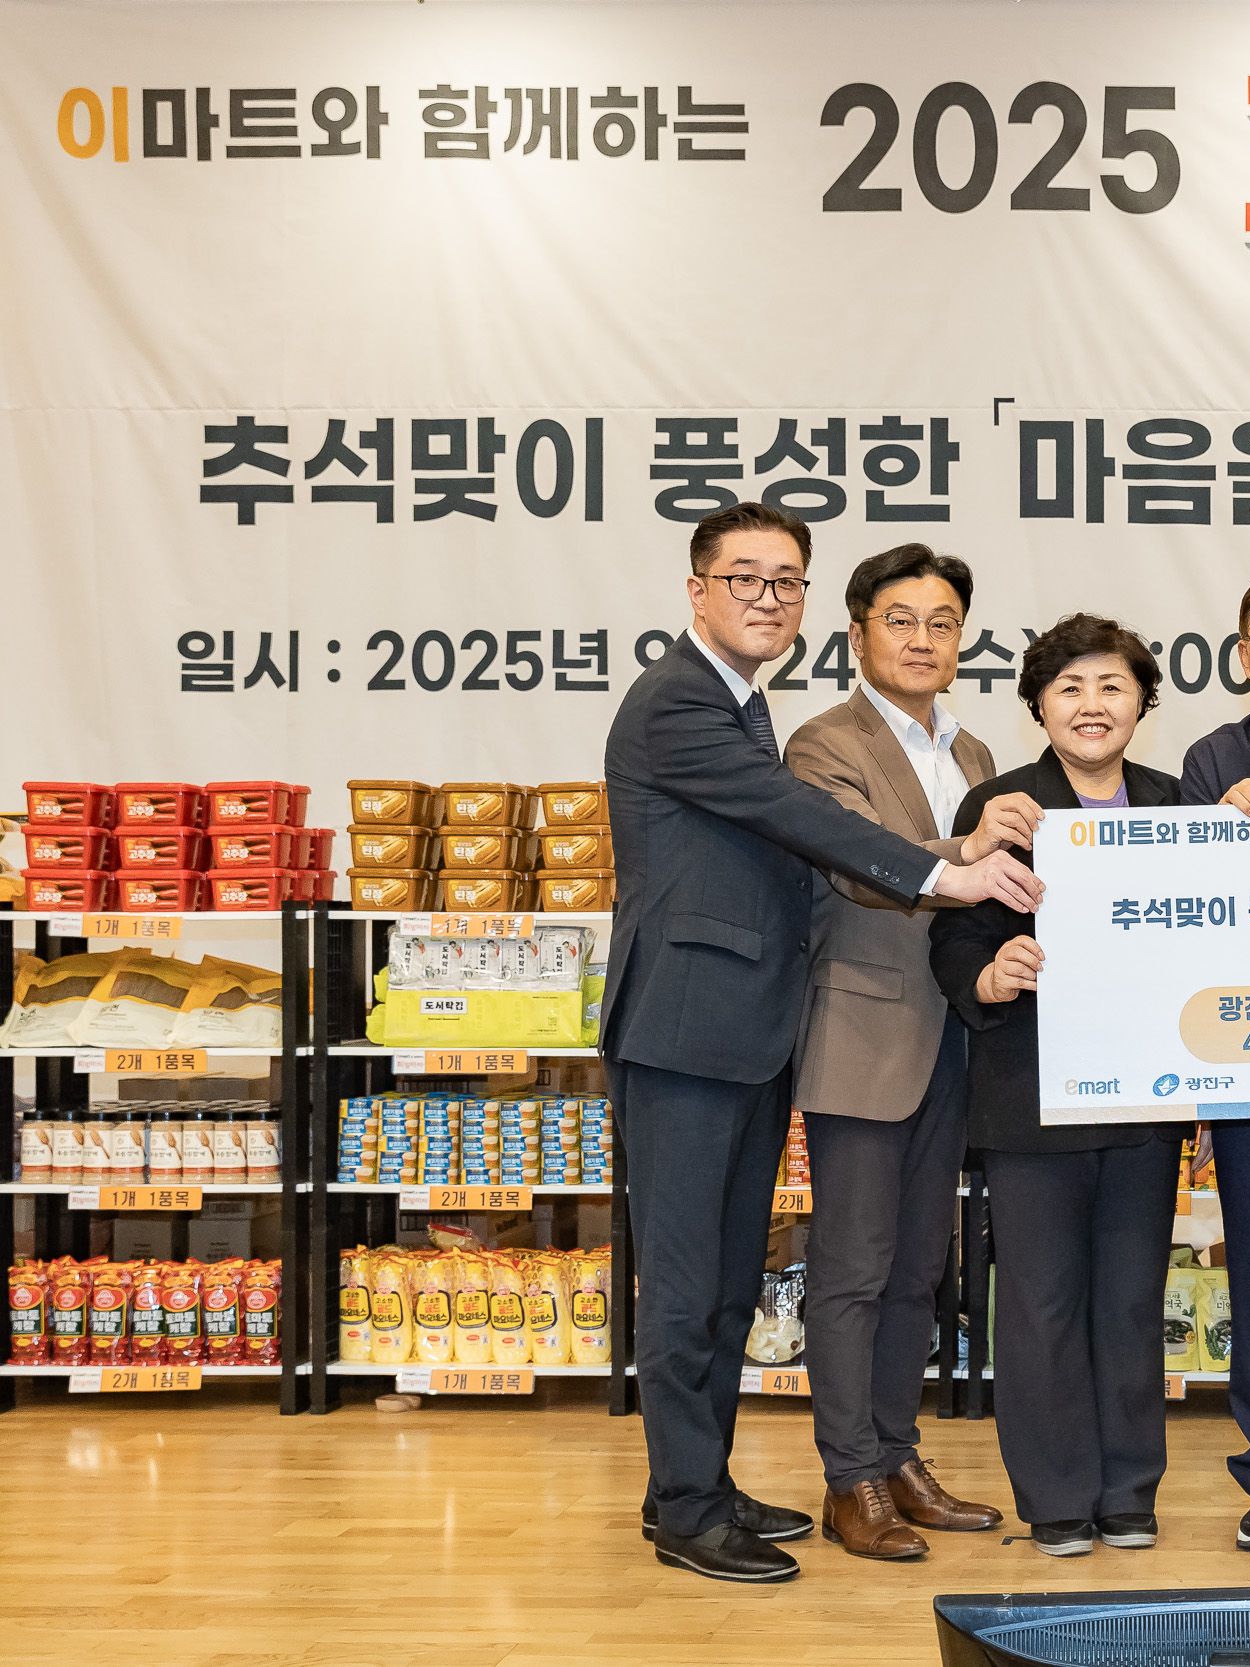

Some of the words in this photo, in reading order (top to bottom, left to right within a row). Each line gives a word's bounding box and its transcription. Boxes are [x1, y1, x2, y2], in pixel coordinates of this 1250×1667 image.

[57, 85, 389, 162] 이마트와
[418, 84, 750, 162] 함께하는
[820, 81, 1180, 214] 2025
[199, 415, 606, 525] 추석맞이
[649, 416, 960, 523] 풍성한
[176, 630, 300, 693] 일시
[366, 628, 610, 693] 2025년
[768, 632, 857, 692] 24
[1070, 819, 1179, 848] 이마트와
[1111, 895, 1236, 931] 추석맞이
[95, 919, 119, 935] 1개
[133, 920, 171, 937] 1품목
[425, 1001, 464, 1011] 도시락김
[117, 1054, 142, 1070] 2개
[156, 1054, 195, 1070] 1품목
[438, 1055, 462, 1071] 1개
[476, 1054, 514, 1071] 1품목
[1065, 1078, 1120, 1096] emart
[1185, 1076, 1235, 1091] 광진구
[113, 1190, 136, 1207] 1개
[150, 1190, 189, 1207] 1품목
[441, 1191, 466, 1207] 2개
[480, 1191, 520, 1207] 1품목
[779, 1194, 804, 1211] 2개
[1164, 1299, 1183, 1310] 역국
[113, 1372, 137, 1389] 2개
[152, 1371, 190, 1388] 1품목
[444, 1374, 468, 1391] 1개
[481, 1374, 521, 1391] 1품목
[774, 1375, 798, 1392] 4개
